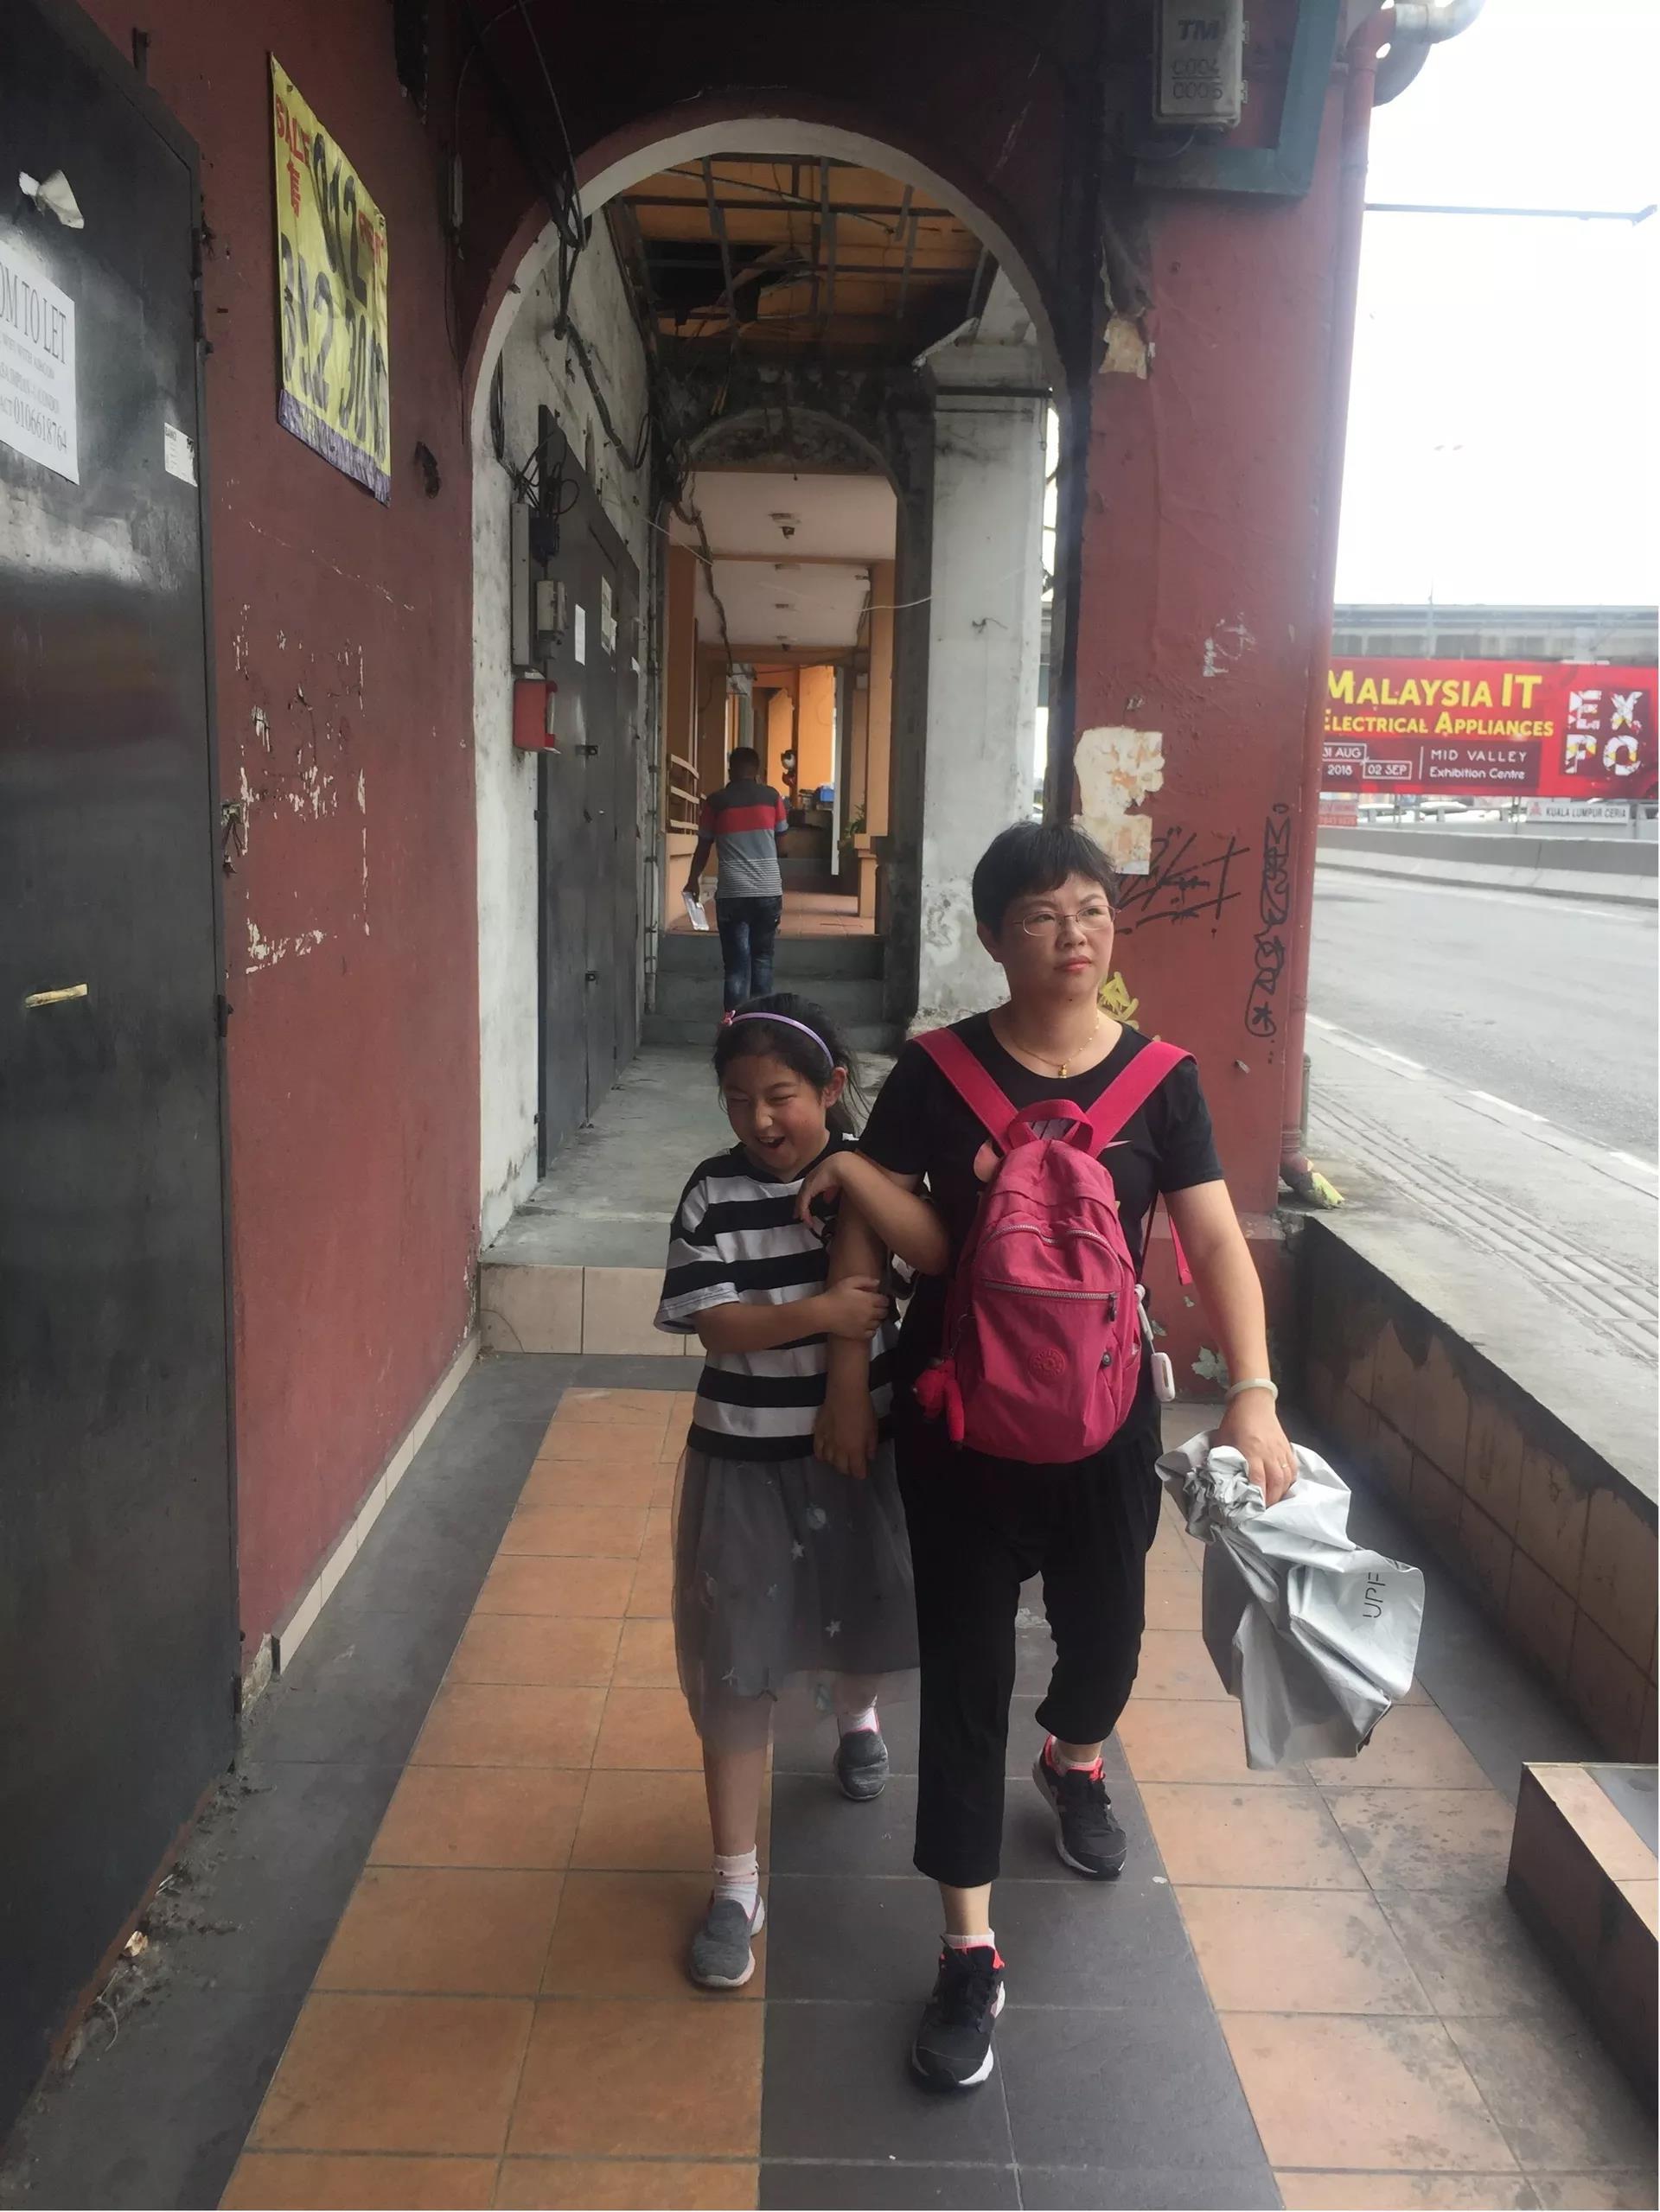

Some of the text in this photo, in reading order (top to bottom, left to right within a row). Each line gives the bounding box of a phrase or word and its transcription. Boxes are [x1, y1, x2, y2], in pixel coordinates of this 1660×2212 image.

[22, 281, 40, 343] TO
[43, 297, 67, 365] LET
[1328, 670, 1542, 709] MALAYSIA IT
[1434, 711, 1555, 736] APPLIANCES
[1335, 747, 1362, 759] AUG
[1431, 749, 1528, 762] MID VALLEY
[1368, 764, 1408, 776] 02 SEP
[1429, 766, 1526, 780] Exhibition Centre
[1546, 806, 1570, 818] KUALA
[1573, 807, 1603, 819] LUMPUR
[1362, 1571, 1387, 1619] UPF
